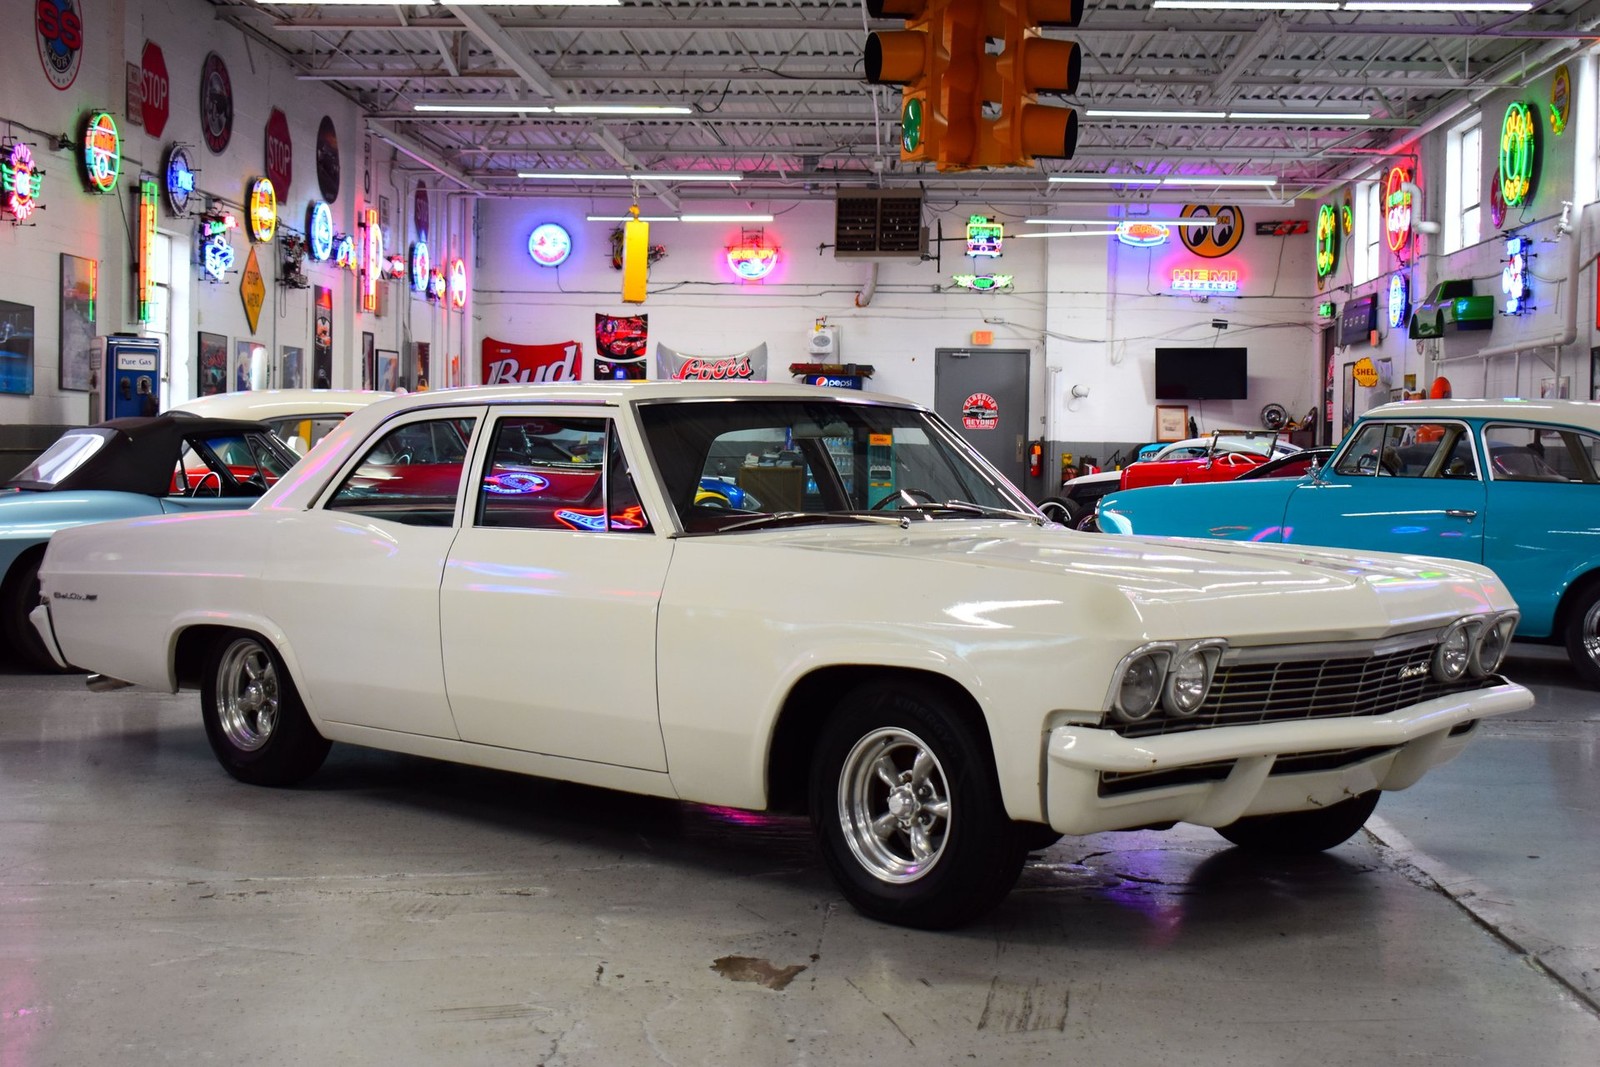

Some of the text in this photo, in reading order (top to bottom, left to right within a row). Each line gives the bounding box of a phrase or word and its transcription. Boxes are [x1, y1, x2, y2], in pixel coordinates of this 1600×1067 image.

[38, 0, 81, 51] SS
[141, 68, 168, 110] STOP
[11, 143, 35, 171] ROUTE
[268, 137, 291, 176] STOP
[1504, 175, 1520, 200] GAS
[9, 194, 36, 220] MOTEL
[969, 226, 1000, 237] drive-in
[1172, 269, 1238, 282] HEMI
[1343, 314, 1366, 328] FORD
[488, 344, 577, 385] Bud
[598, 364, 610, 374] 3
[672, 355, 753, 380] Coors
[828, 378, 853, 388] pepsi
[965, 393, 997, 408] CLASSICS
[966, 418, 995, 426] BEYOND
